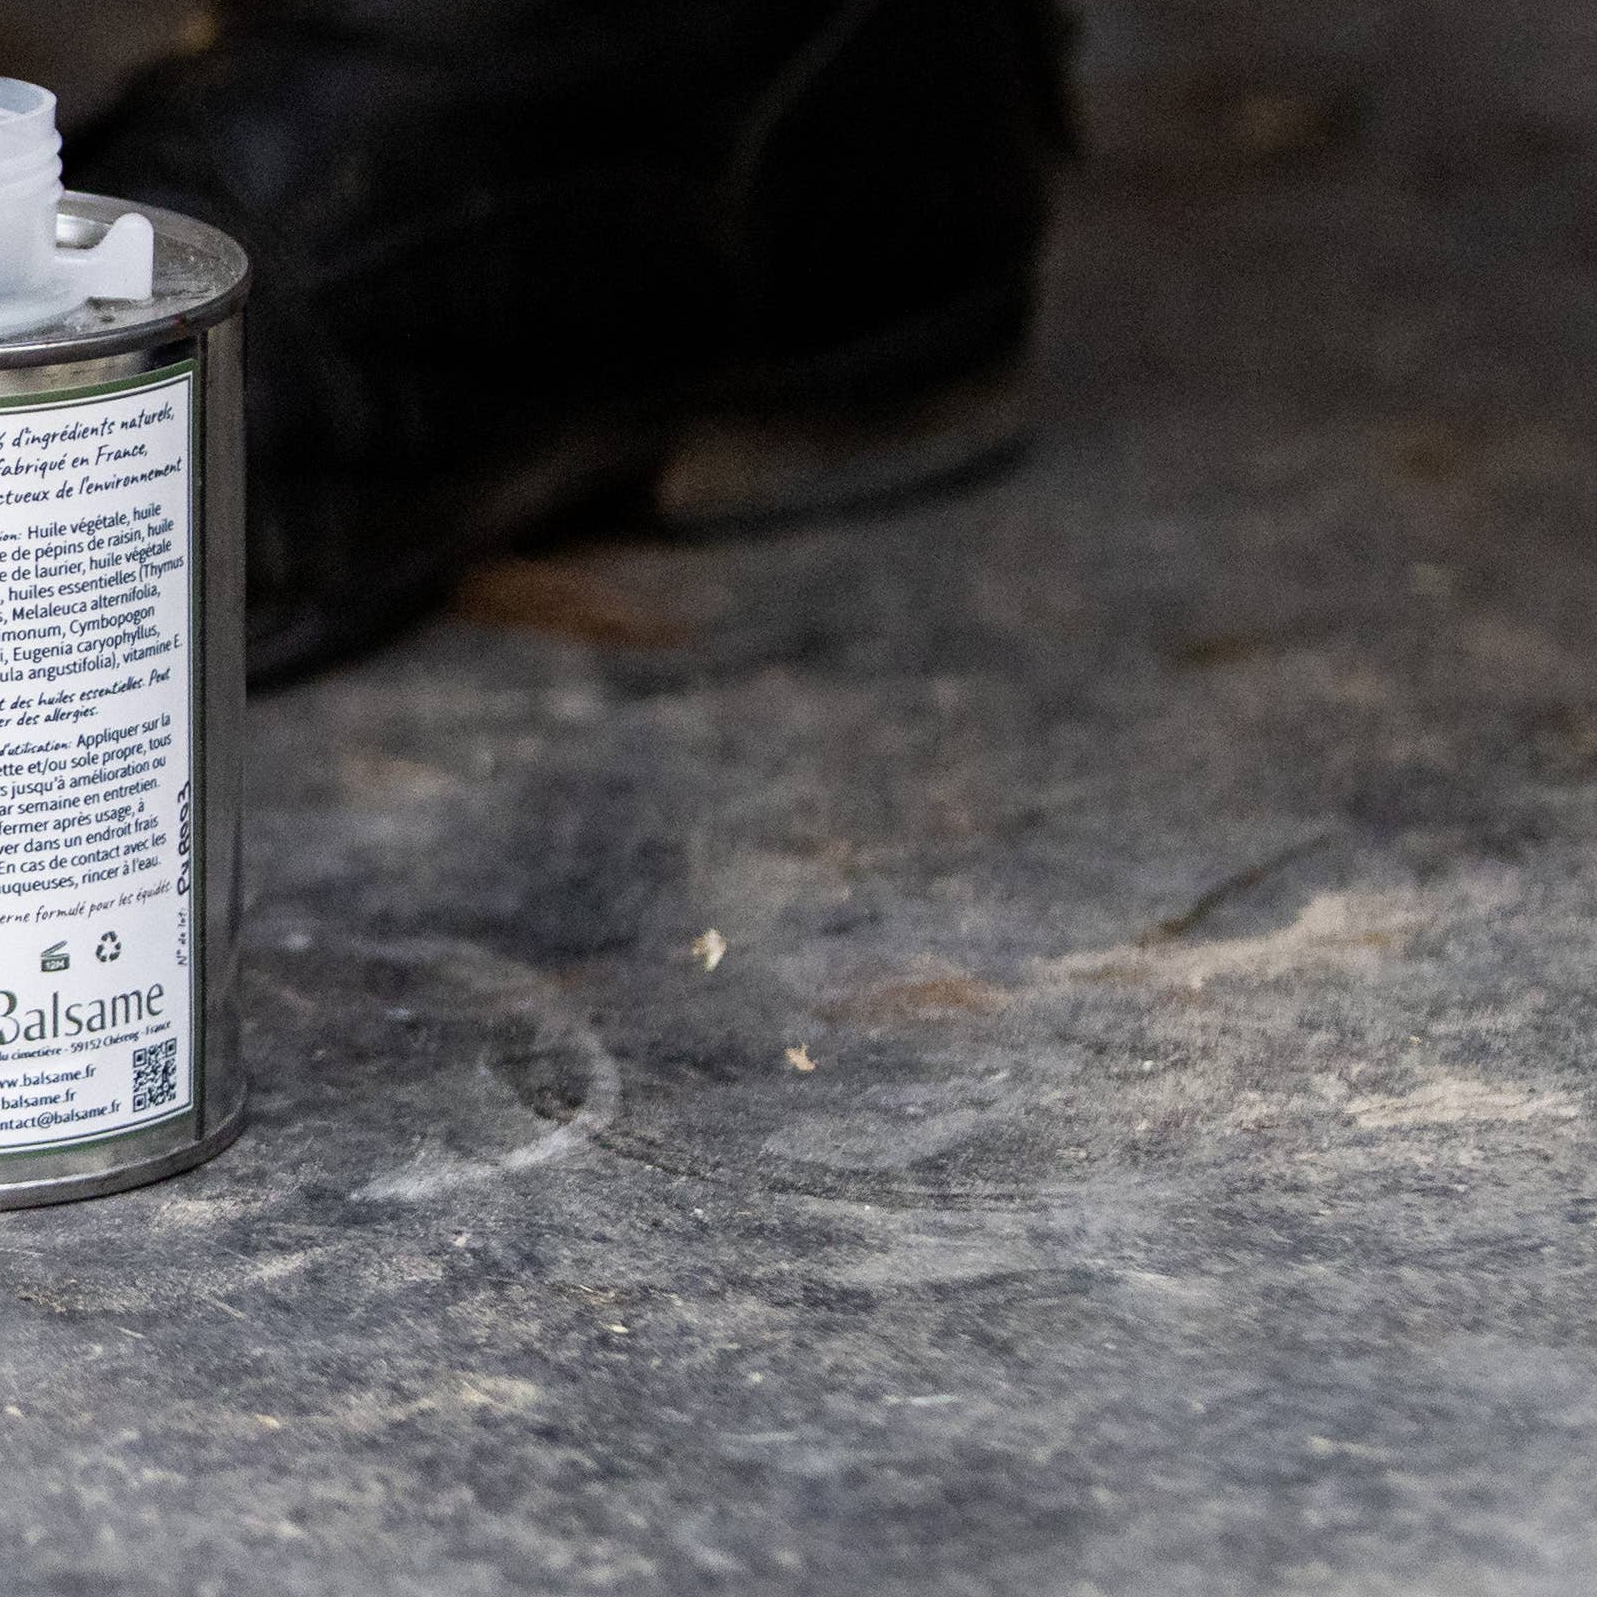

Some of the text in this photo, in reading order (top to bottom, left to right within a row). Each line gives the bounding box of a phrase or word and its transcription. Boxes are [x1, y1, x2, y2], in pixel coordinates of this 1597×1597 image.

[120, 402, 175, 430] naturels,
[72, 456, 89, 468] en
[95, 443, 148, 466] France,
[56, 481, 73, 499] de
[79, 456, 182, 494] l'environnement
[28, 519, 67, 539] Huile
[70, 512, 130, 536] végétale,
[133, 503, 161, 522] huile
[11, 547, 31, 561] de
[35, 536, 84, 562] pépins
[88, 535, 104, 550] de
[107, 527, 145, 547] raisin,
[148, 519, 174, 537] huile
[8, 585, 54, 601] huiles
[58, 571, 137, 595] essentielles
[139, 555, 184, 579] (Thymus
[11, 566, 31, 581] de
[35, 561, 86, 578] laurier,
[90, 549, 122, 570] huile
[125, 540, 172, 562] végétale
[12, 601, 87, 621] Melaleuca
[90, 585, 161, 611] alternifolia,
[69, 605, 156, 635] Cymbopogon
[13, 642, 73, 663] Eugenia
[77, 623, 160, 654] caryophyllus,
[28, 656, 120, 683] angustifolia),
[123, 640, 171, 664] vitamine
[10, 694, 32, 710] des
[38, 689, 74, 706] huiles
[17, 713, 40, 727] des
[76, 724, 139, 749] Appliquer
[142, 721, 158, 734] sur
[161, 713, 171, 727] la
[28, 759, 67, 775] et/ou
[71, 751, 99, 768] sole
[102, 744, 146, 767] propre,
[149, 734, 172, 752] tous
[11, 775, 65, 800] jusqu'à
[70, 760, 150, 789] amélioration
[152, 755, 166, 770] ou
[18, 794, 80, 814] semaine
[83, 793, 100, 805] en
[53, 812, 92, 833] après
[96, 806, 136, 824] usage,
[138, 799, 145, 813] à
[24, 836, 60, 853] dans
[64, 835, 82, 847] un
[86, 824, 132, 845] endroit
[134, 815, 158, 833] frais
[20, 857, 44, 872] cas
[49, 854, 67, 869] de
[71, 846, 120, 866] contact
[124, 840, 149, 855] avec
[151, 833, 167, 846] les
[82, 867, 120, 885] rincer
[122, 858, 130, 874] à
[35, 903, 85, 924] formulé
[88, 898, 116, 917] pour
[119, 894, 133, 906] les
[178, 930, 187, 945] de
[71, 1039, 101, 1054] 59152
[146, 1020, 171, 1035] France
[1, 1088, 76, 1110] balsame.fr
